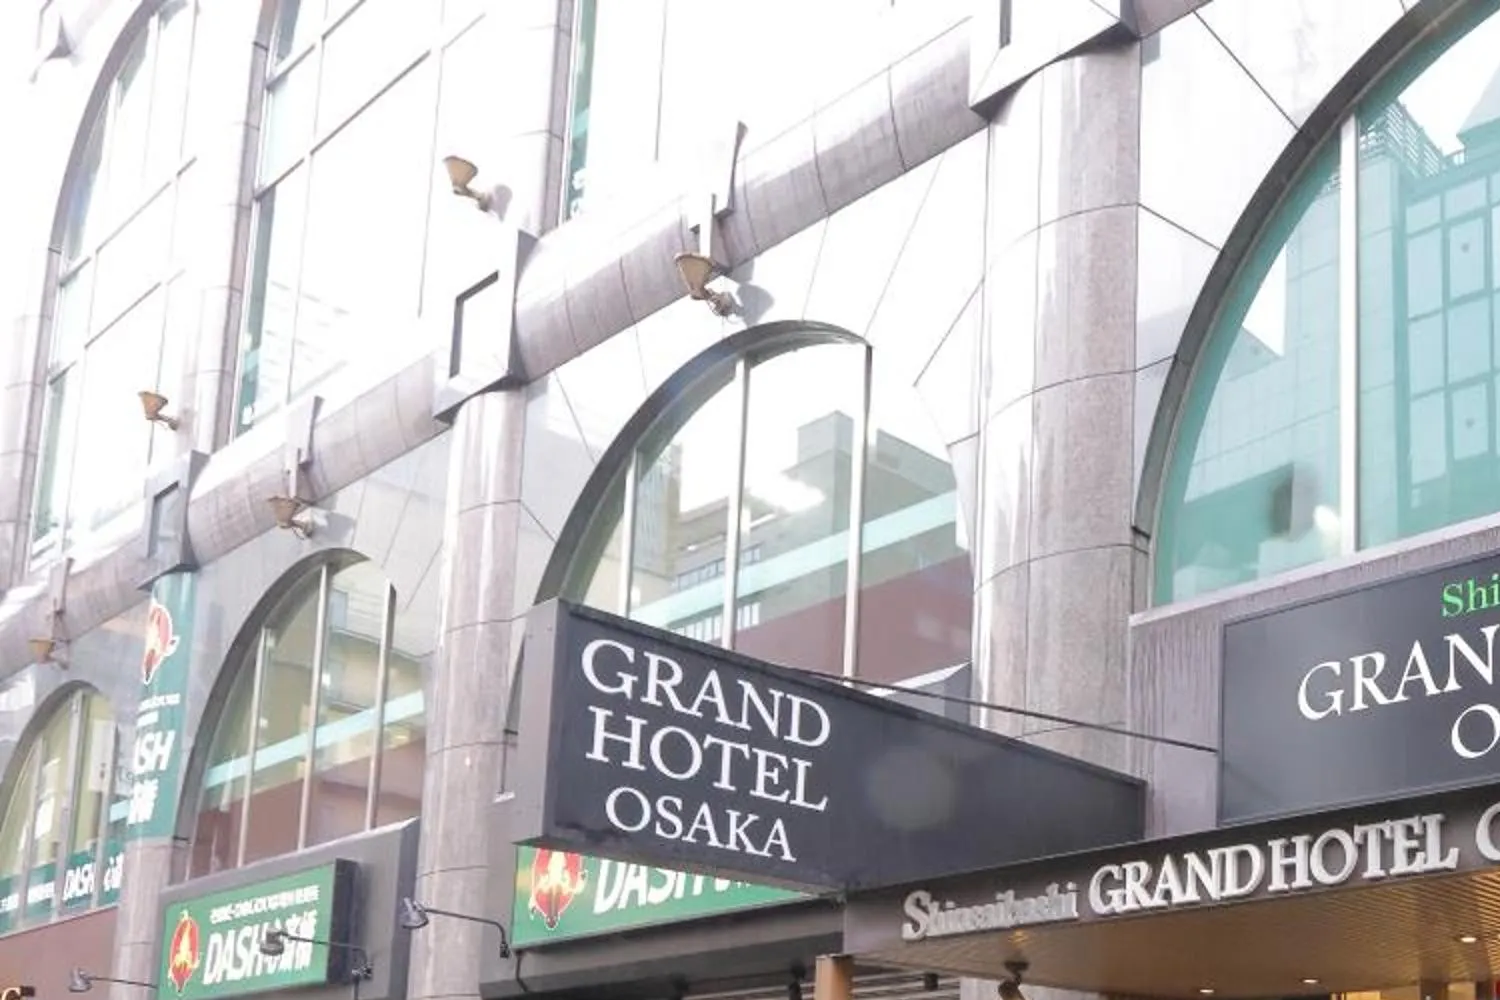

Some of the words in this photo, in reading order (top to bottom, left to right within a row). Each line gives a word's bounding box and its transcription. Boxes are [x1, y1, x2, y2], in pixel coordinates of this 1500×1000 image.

[581, 638, 831, 747] GRAND
[585, 705, 829, 812] HOTEL
[605, 786, 797, 863] OSAKA
[902, 881, 1079, 941] Shinsaibashi
[1089, 842, 1265, 916] GRAND
[1267, 813, 1460, 893] HOTEL
